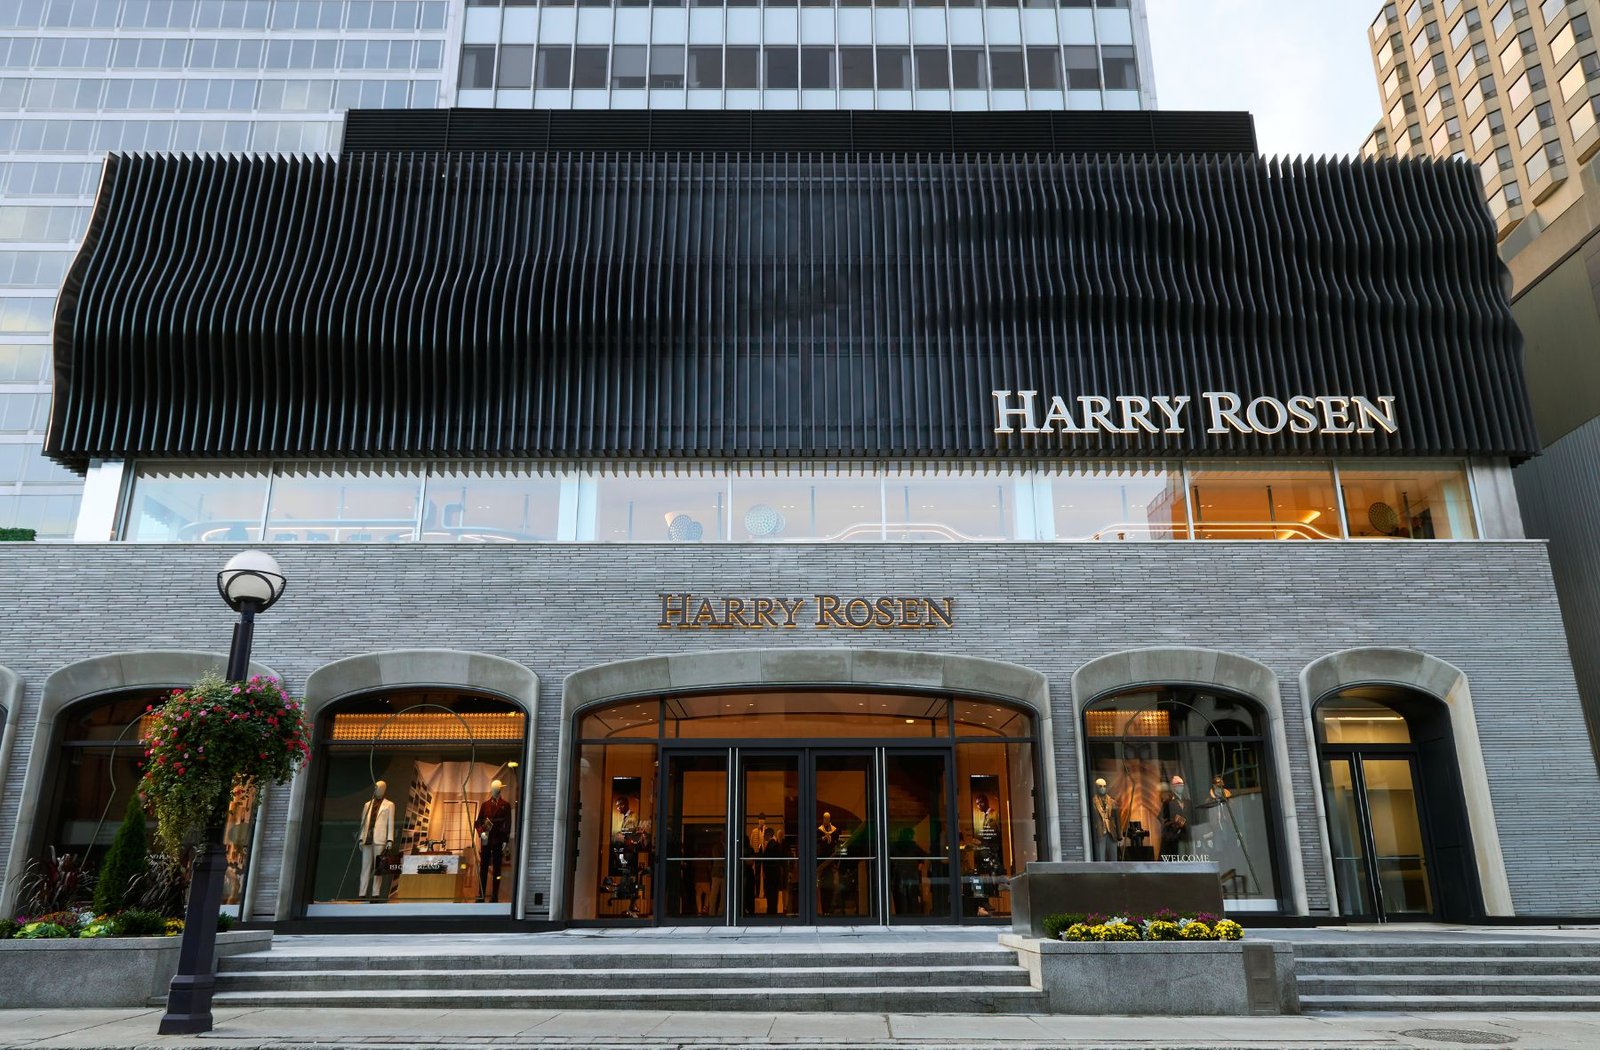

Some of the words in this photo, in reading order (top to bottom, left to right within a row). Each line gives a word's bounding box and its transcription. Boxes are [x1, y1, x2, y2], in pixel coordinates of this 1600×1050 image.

[992, 390, 1190, 433] HARRY
[1202, 391, 1399, 434] ROSEN
[658, 593, 803, 628] HARRY
[814, 594, 954, 628] ROSEN
[1161, 854, 1210, 863] WELCOME
